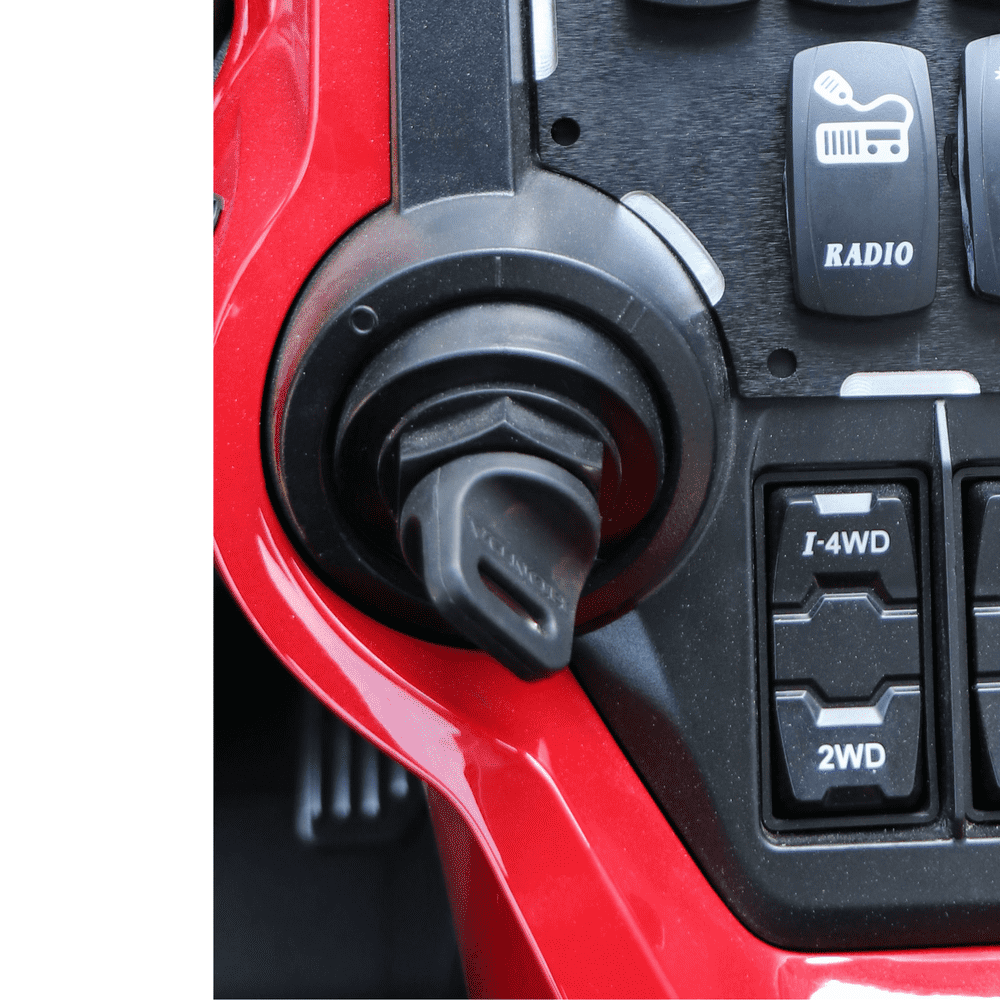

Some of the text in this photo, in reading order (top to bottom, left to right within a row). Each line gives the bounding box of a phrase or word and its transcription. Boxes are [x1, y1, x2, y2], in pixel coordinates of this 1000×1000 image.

[823, 241, 914, 268] RADIO
[802, 529, 890, 556] I-4WD
[817, 742, 887, 771] 2WD
